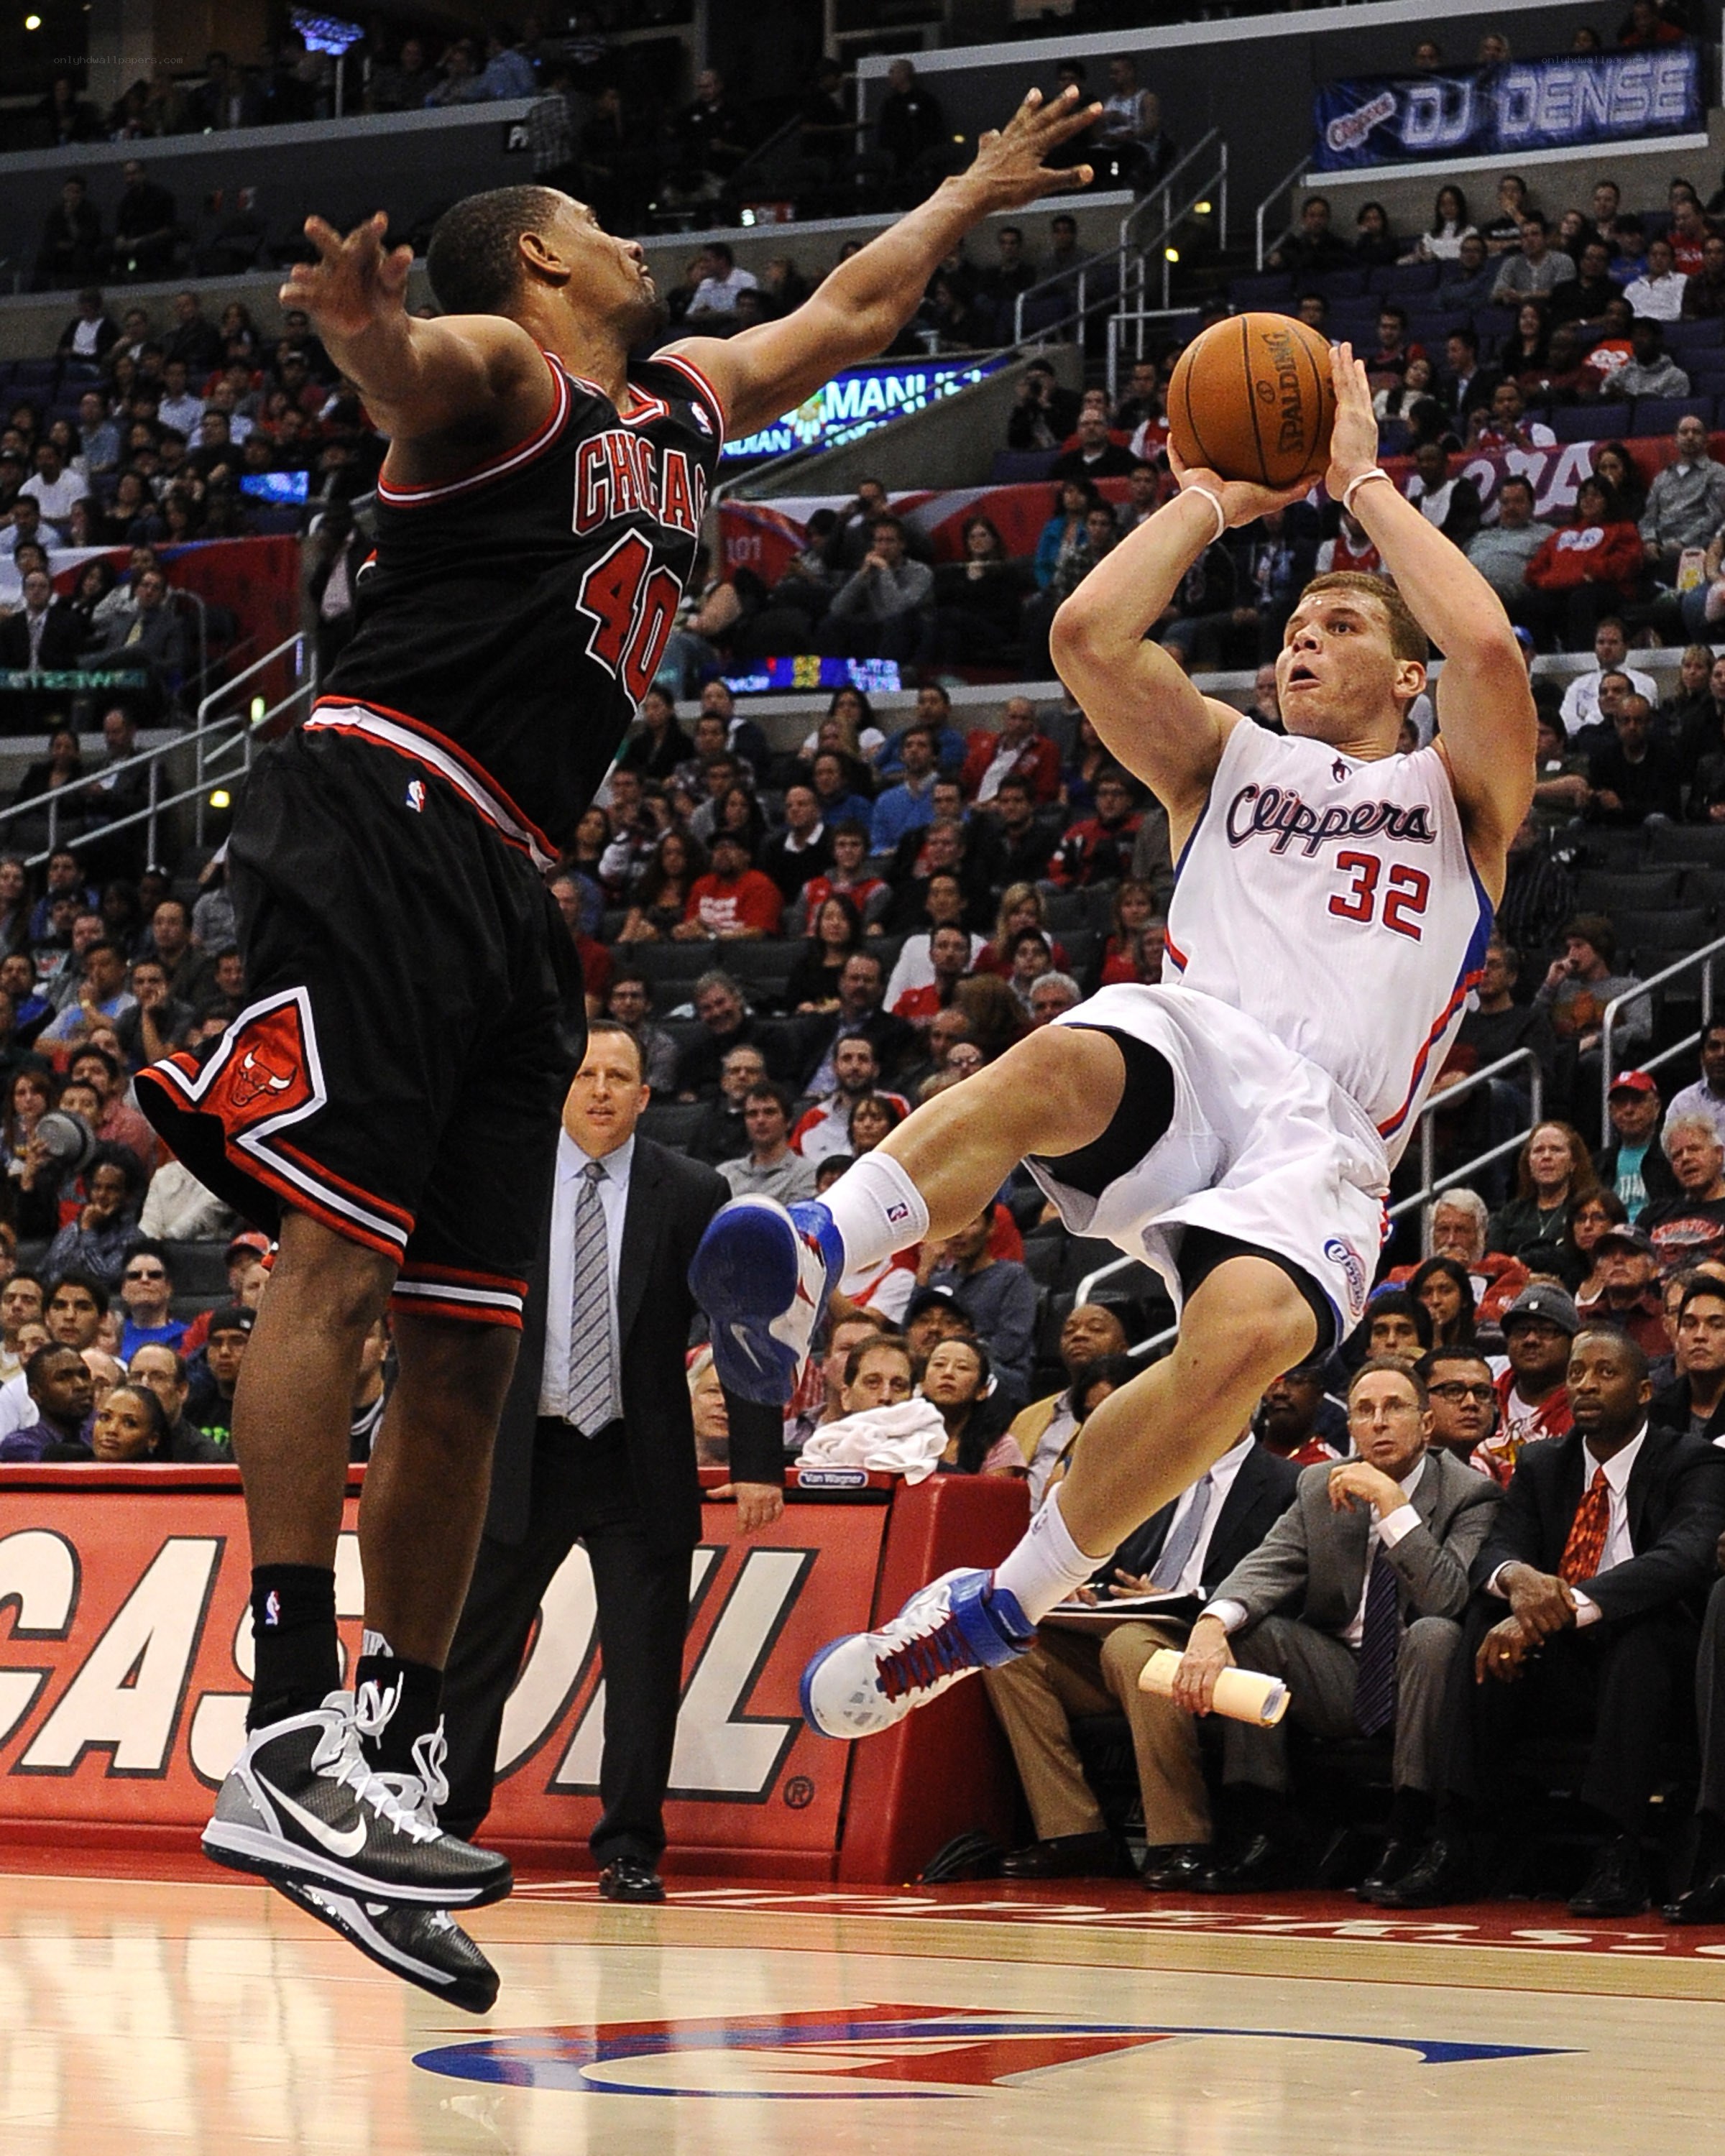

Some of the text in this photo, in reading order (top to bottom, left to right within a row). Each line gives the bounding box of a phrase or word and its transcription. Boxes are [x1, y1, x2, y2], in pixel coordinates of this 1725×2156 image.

[1402, 83, 1471, 145] DJ
[1498, 55, 1690, 137] DENSE
[1261, 329, 1304, 453] SPALDING
[576, 528, 683, 717] 40
[1226, 783, 1437, 858] Clippers
[1328, 850, 1431, 945] 32
